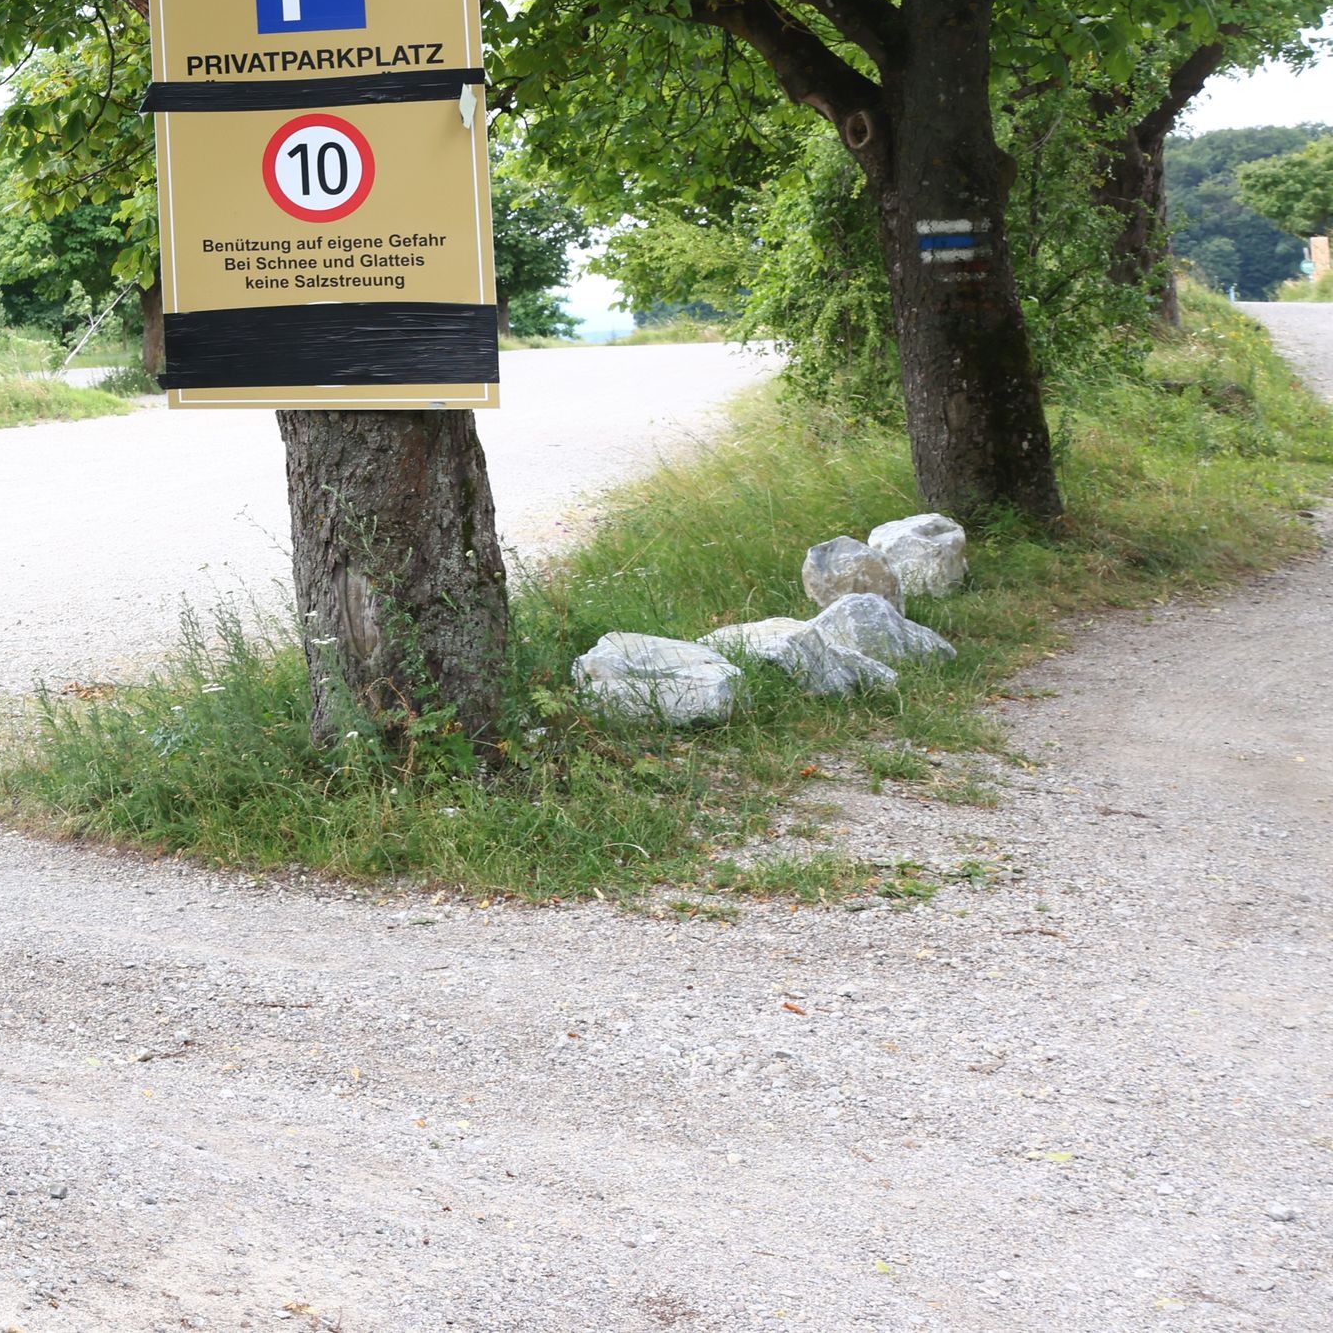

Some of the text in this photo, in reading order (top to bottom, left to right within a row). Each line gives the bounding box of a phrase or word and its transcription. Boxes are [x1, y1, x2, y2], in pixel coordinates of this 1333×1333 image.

[186, 43, 445, 76] PRIVATPARKPLATZ
[287, 141, 348, 196] 10
[202, 233, 447, 254] Benützung auf eigene Gefahr
[224, 253, 425, 271] Bei Schnee und Glatteis
[245, 274, 405, 290] keine Salzstreuung
